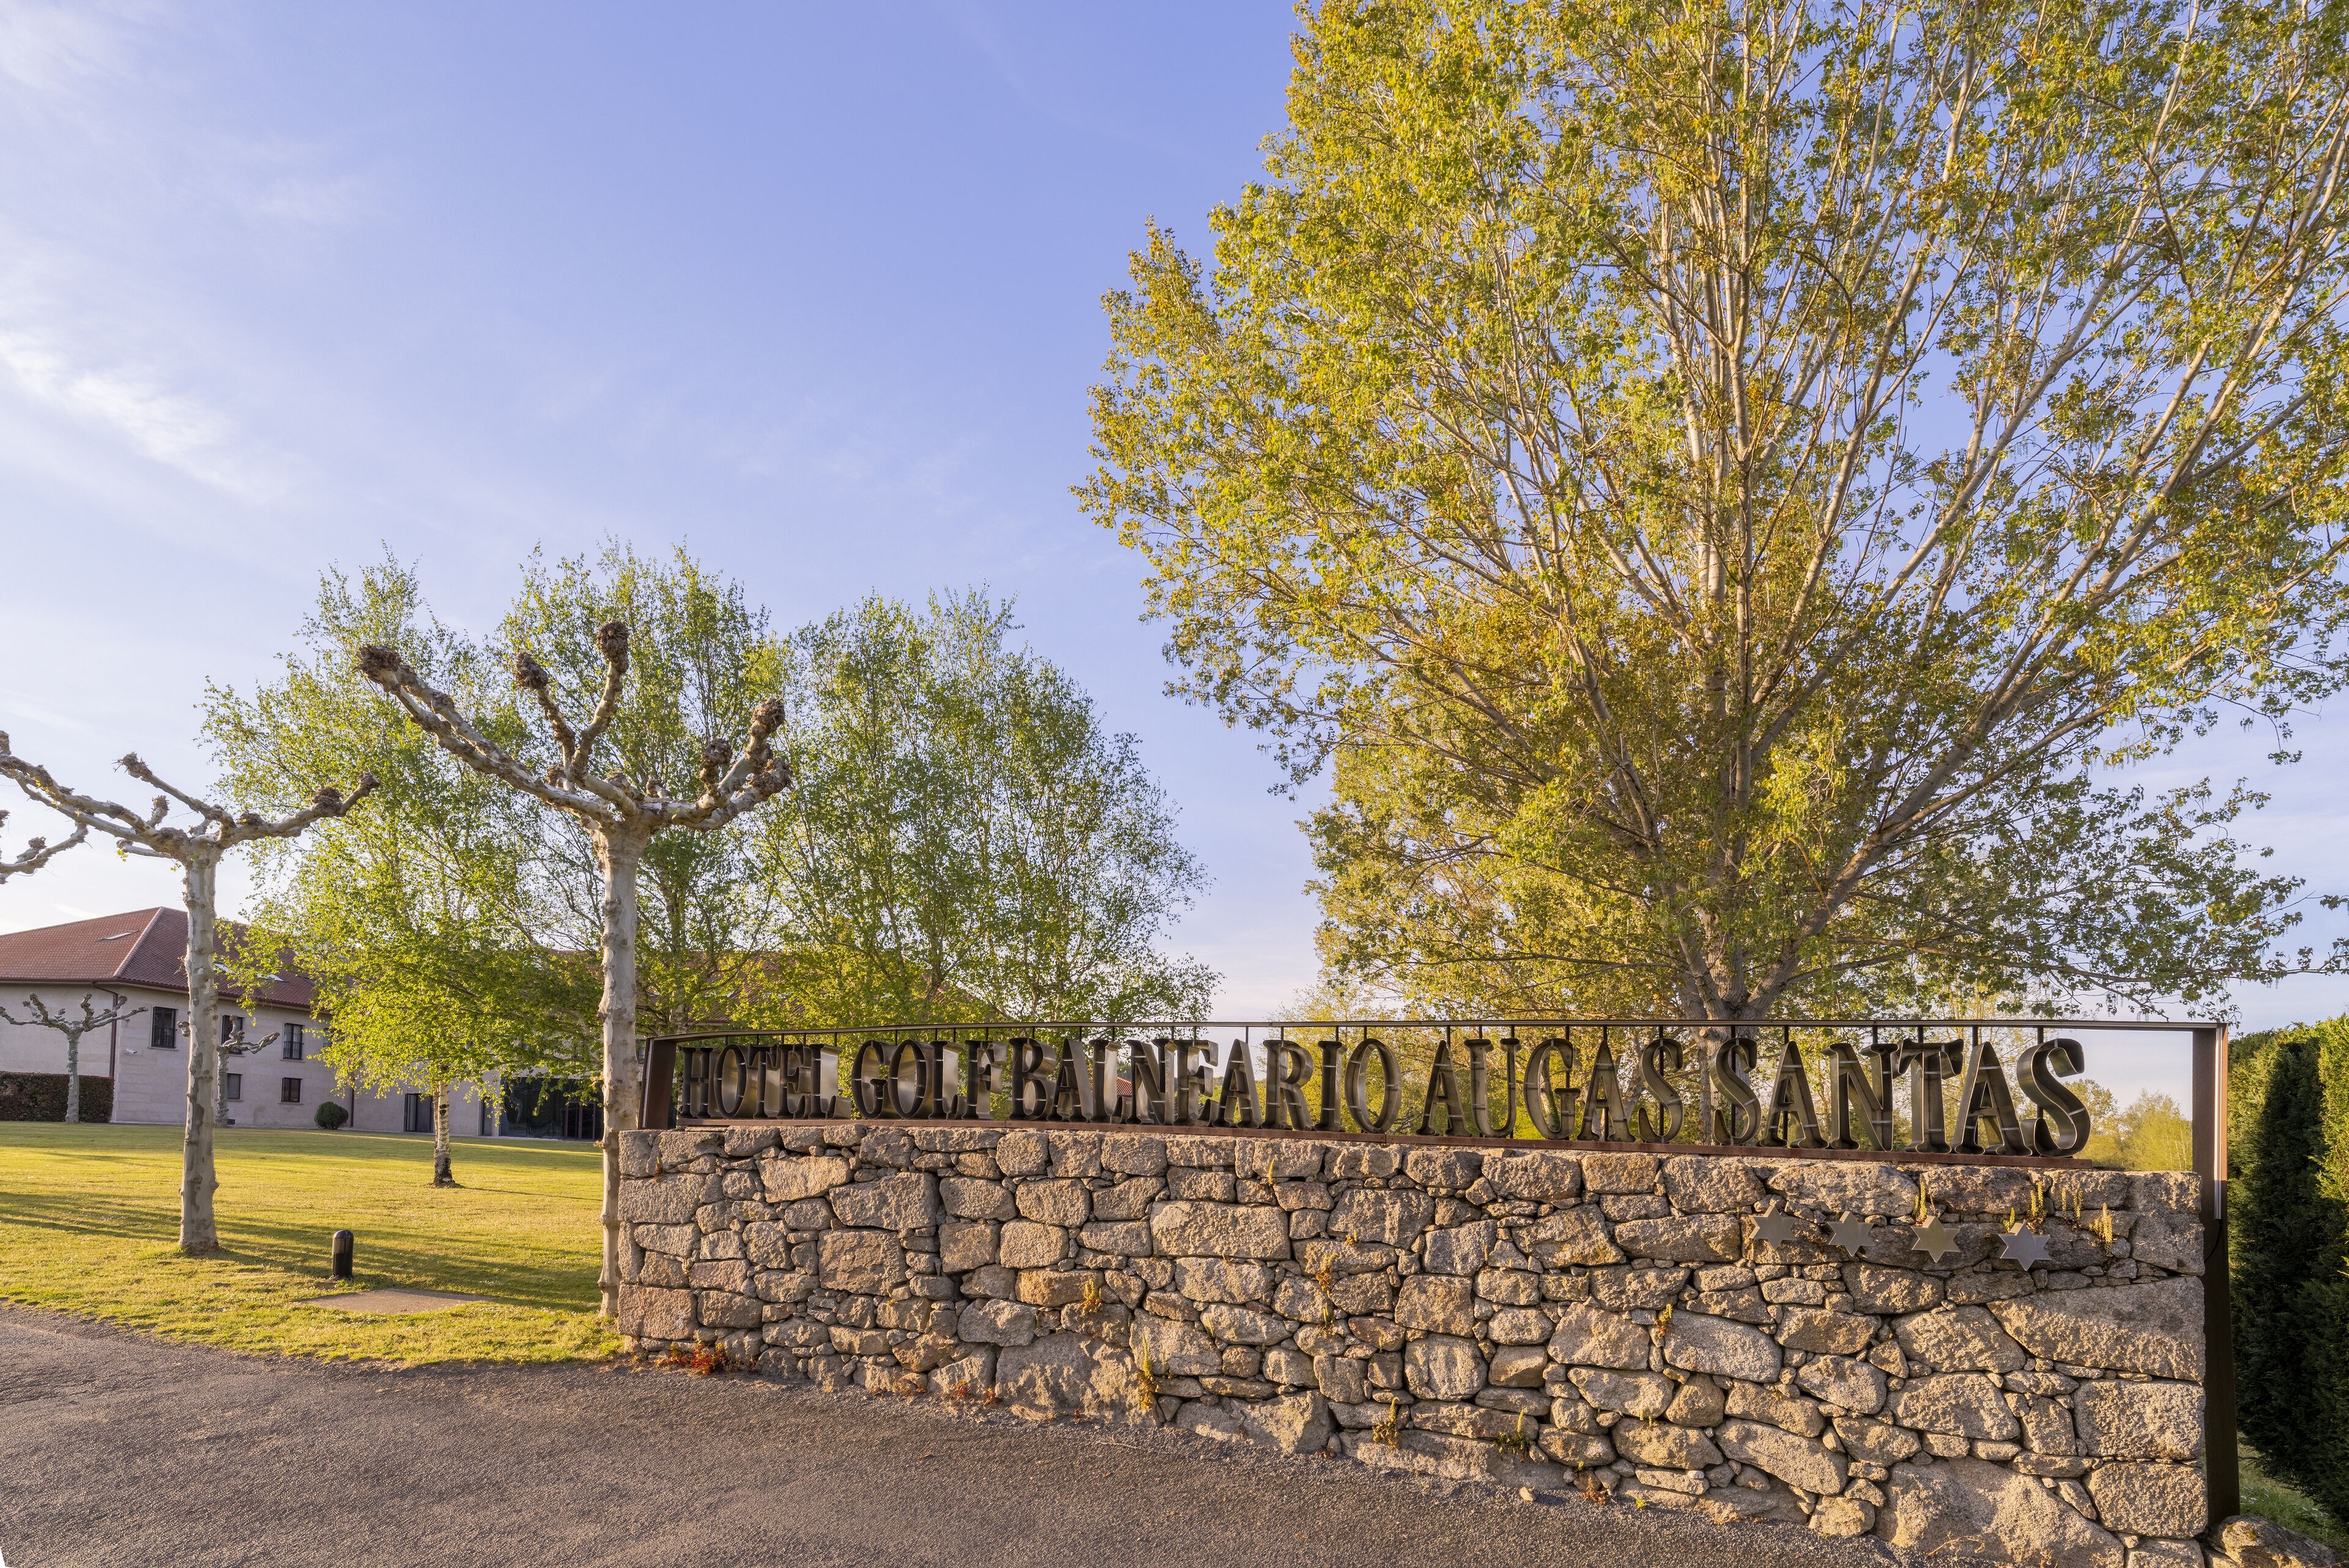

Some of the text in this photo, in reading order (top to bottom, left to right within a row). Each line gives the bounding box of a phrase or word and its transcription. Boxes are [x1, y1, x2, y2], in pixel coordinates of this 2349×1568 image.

[678, 1038, 2091, 1158] HOTEL GOLF BALNEARIO AUGAS SANTAS
